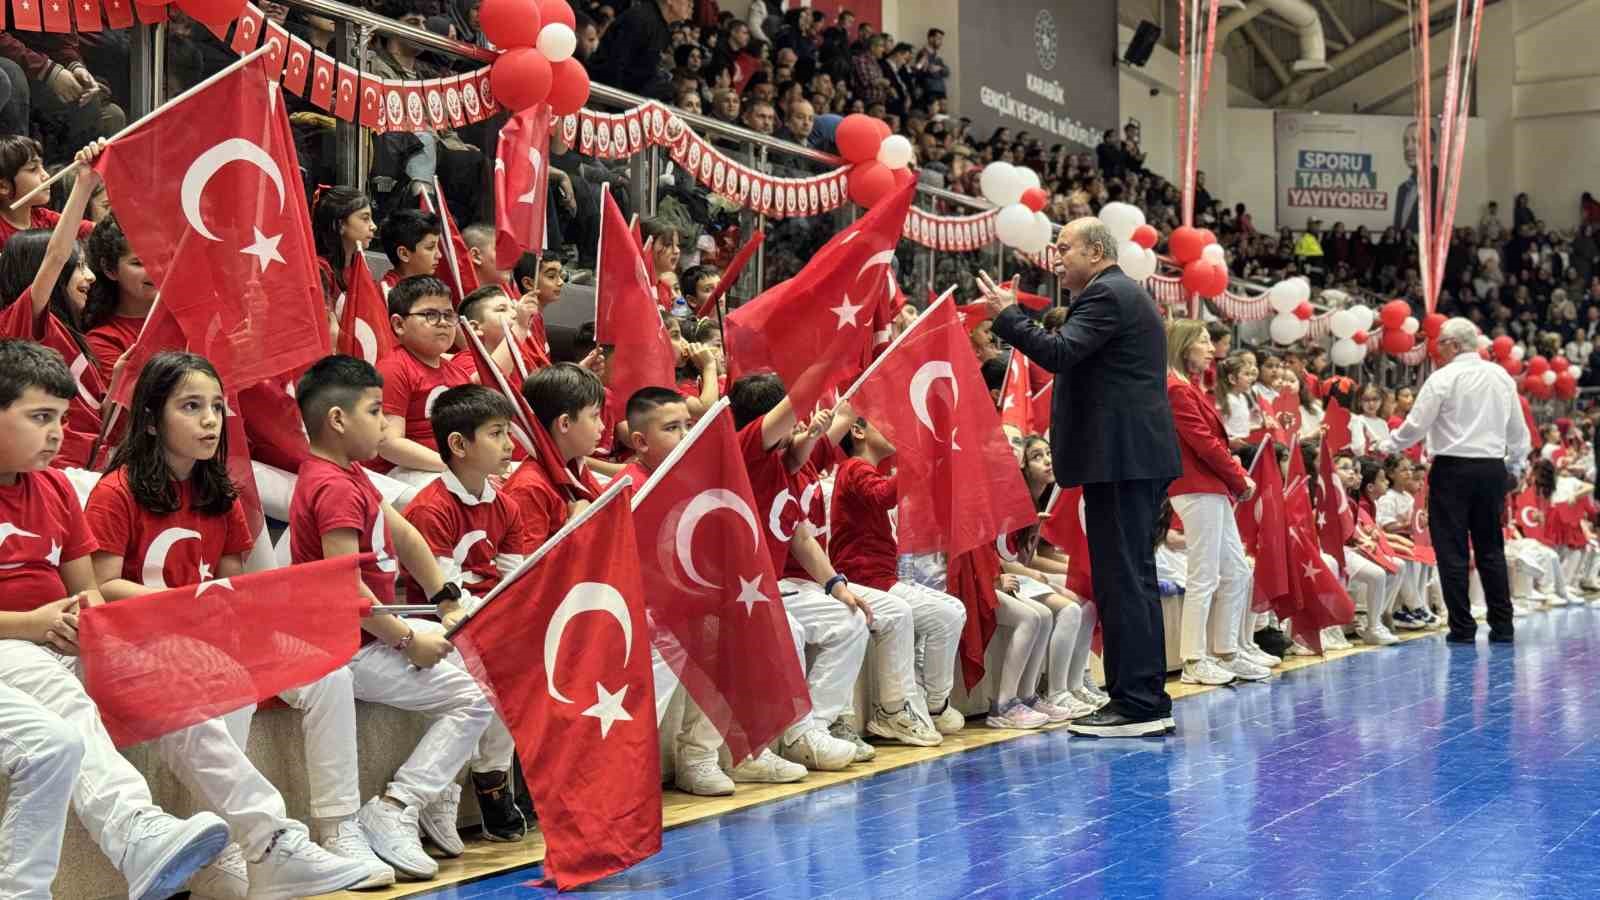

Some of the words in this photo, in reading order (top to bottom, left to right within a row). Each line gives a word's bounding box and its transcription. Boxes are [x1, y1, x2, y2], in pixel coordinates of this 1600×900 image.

[1026, 73, 1065, 105] KARABÜK
[980, 86, 1016, 117] GENÇLİK
[1016, 100, 1027, 121] VE
[1027, 104, 1049, 127] SPOR
[1304, 153, 1362, 170] SPORU
[1300, 172, 1370, 188] TABANA
[1290, 190, 1386, 209] YAYIYORUZ
